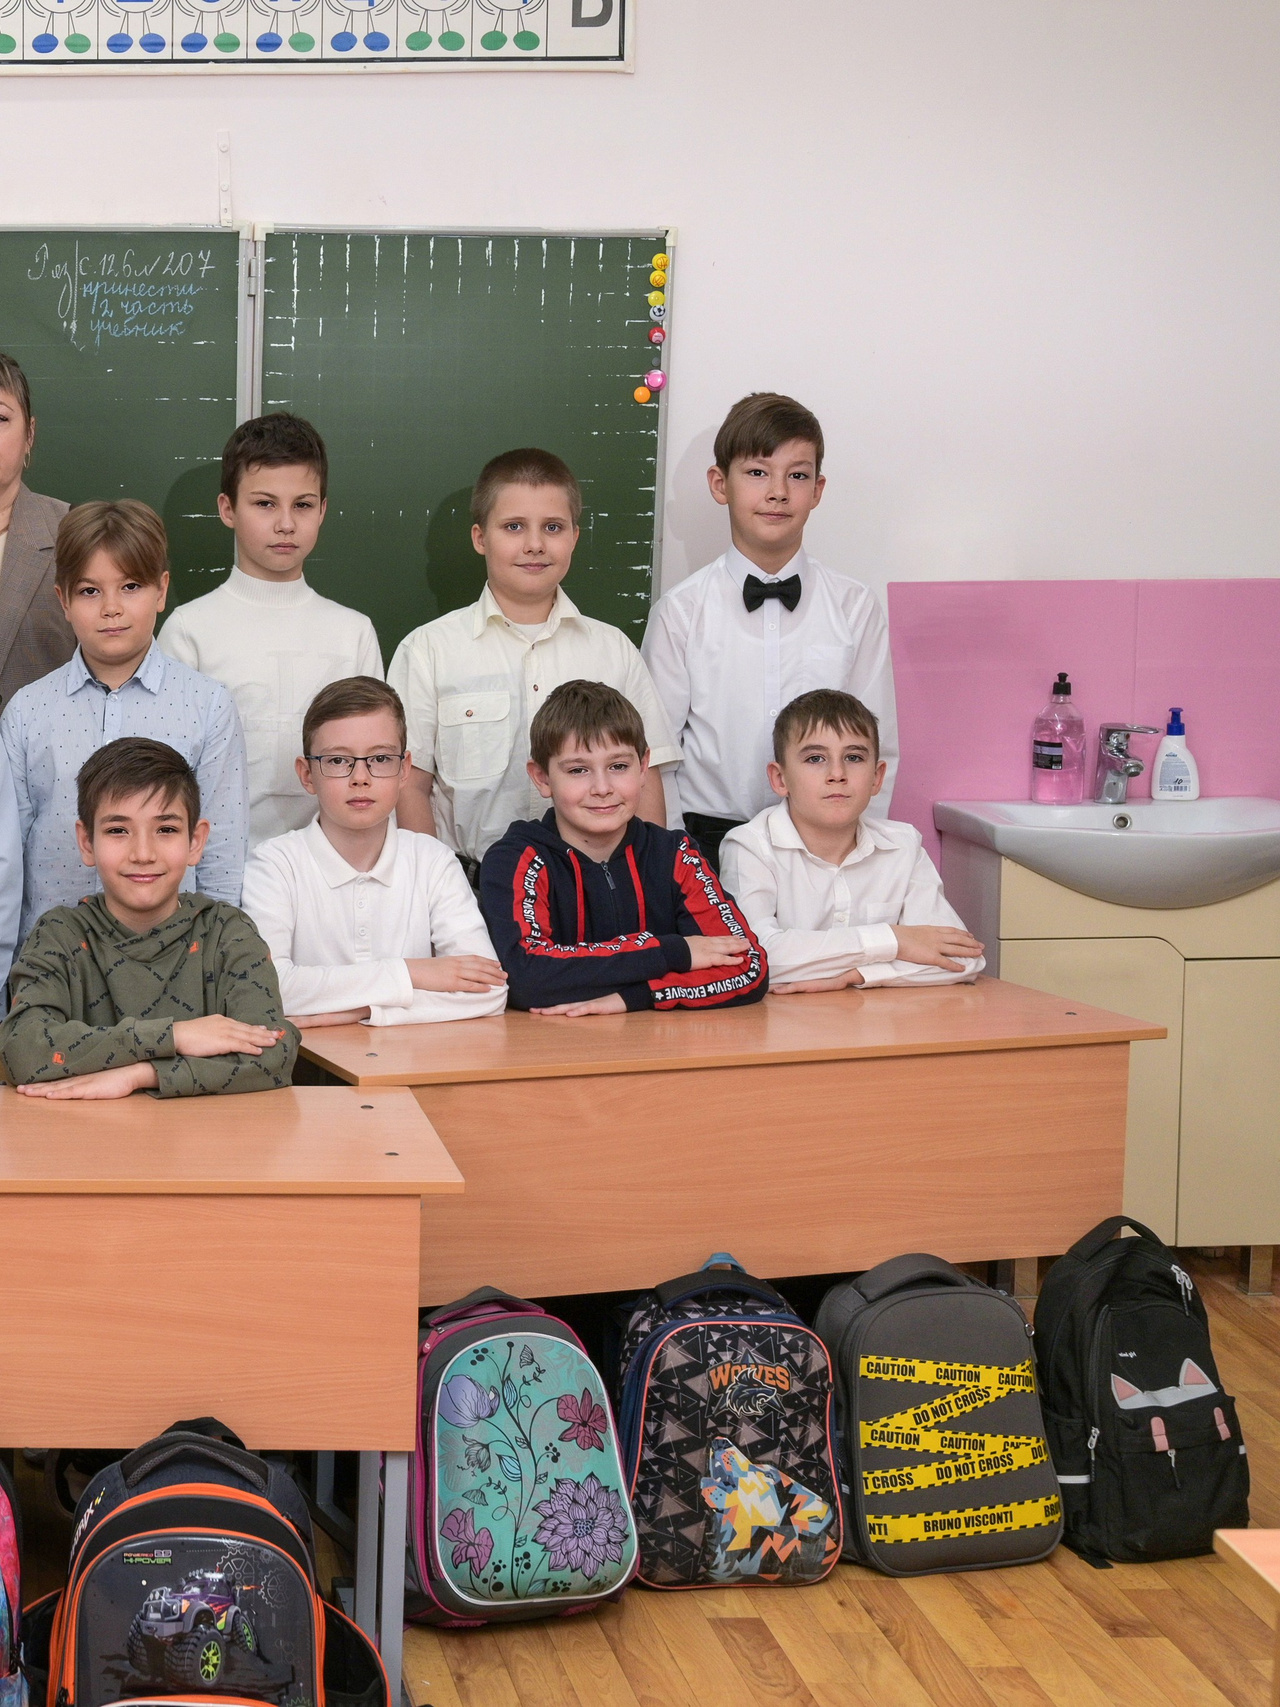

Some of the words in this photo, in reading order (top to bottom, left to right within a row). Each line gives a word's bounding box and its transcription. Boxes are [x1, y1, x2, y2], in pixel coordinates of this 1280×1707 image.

[99, 299, 114, 318] 2
[120, 299, 195, 317] часть
[90, 315, 187, 348] учебник
[67, 1041, 81, 1052] FILA
[156, 1032, 167, 1045] FILA
[866, 1361, 916, 1377] CAUTION
[935, 1367, 981, 1383] CAUTION
[998, 1372, 1034, 1388] CAUTION
[912, 1411, 931, 1426] DO
[932, 1403, 955, 1420] NOT
[954, 1387, 991, 1410] CROSS
[870, 1429, 920, 1446] CAUTION
[940, 1436, 985, 1452] CAUTION
[872, 1472, 915, 1490] CROSS
[936, 1466, 952, 1481] DO
[955, 1461, 977, 1477] NOT
[978, 1453, 1014, 1472] CROSS
[923, 1516, 962, 1533] BRUNO
[964, 1511, 1013, 1529] VISCONTI
